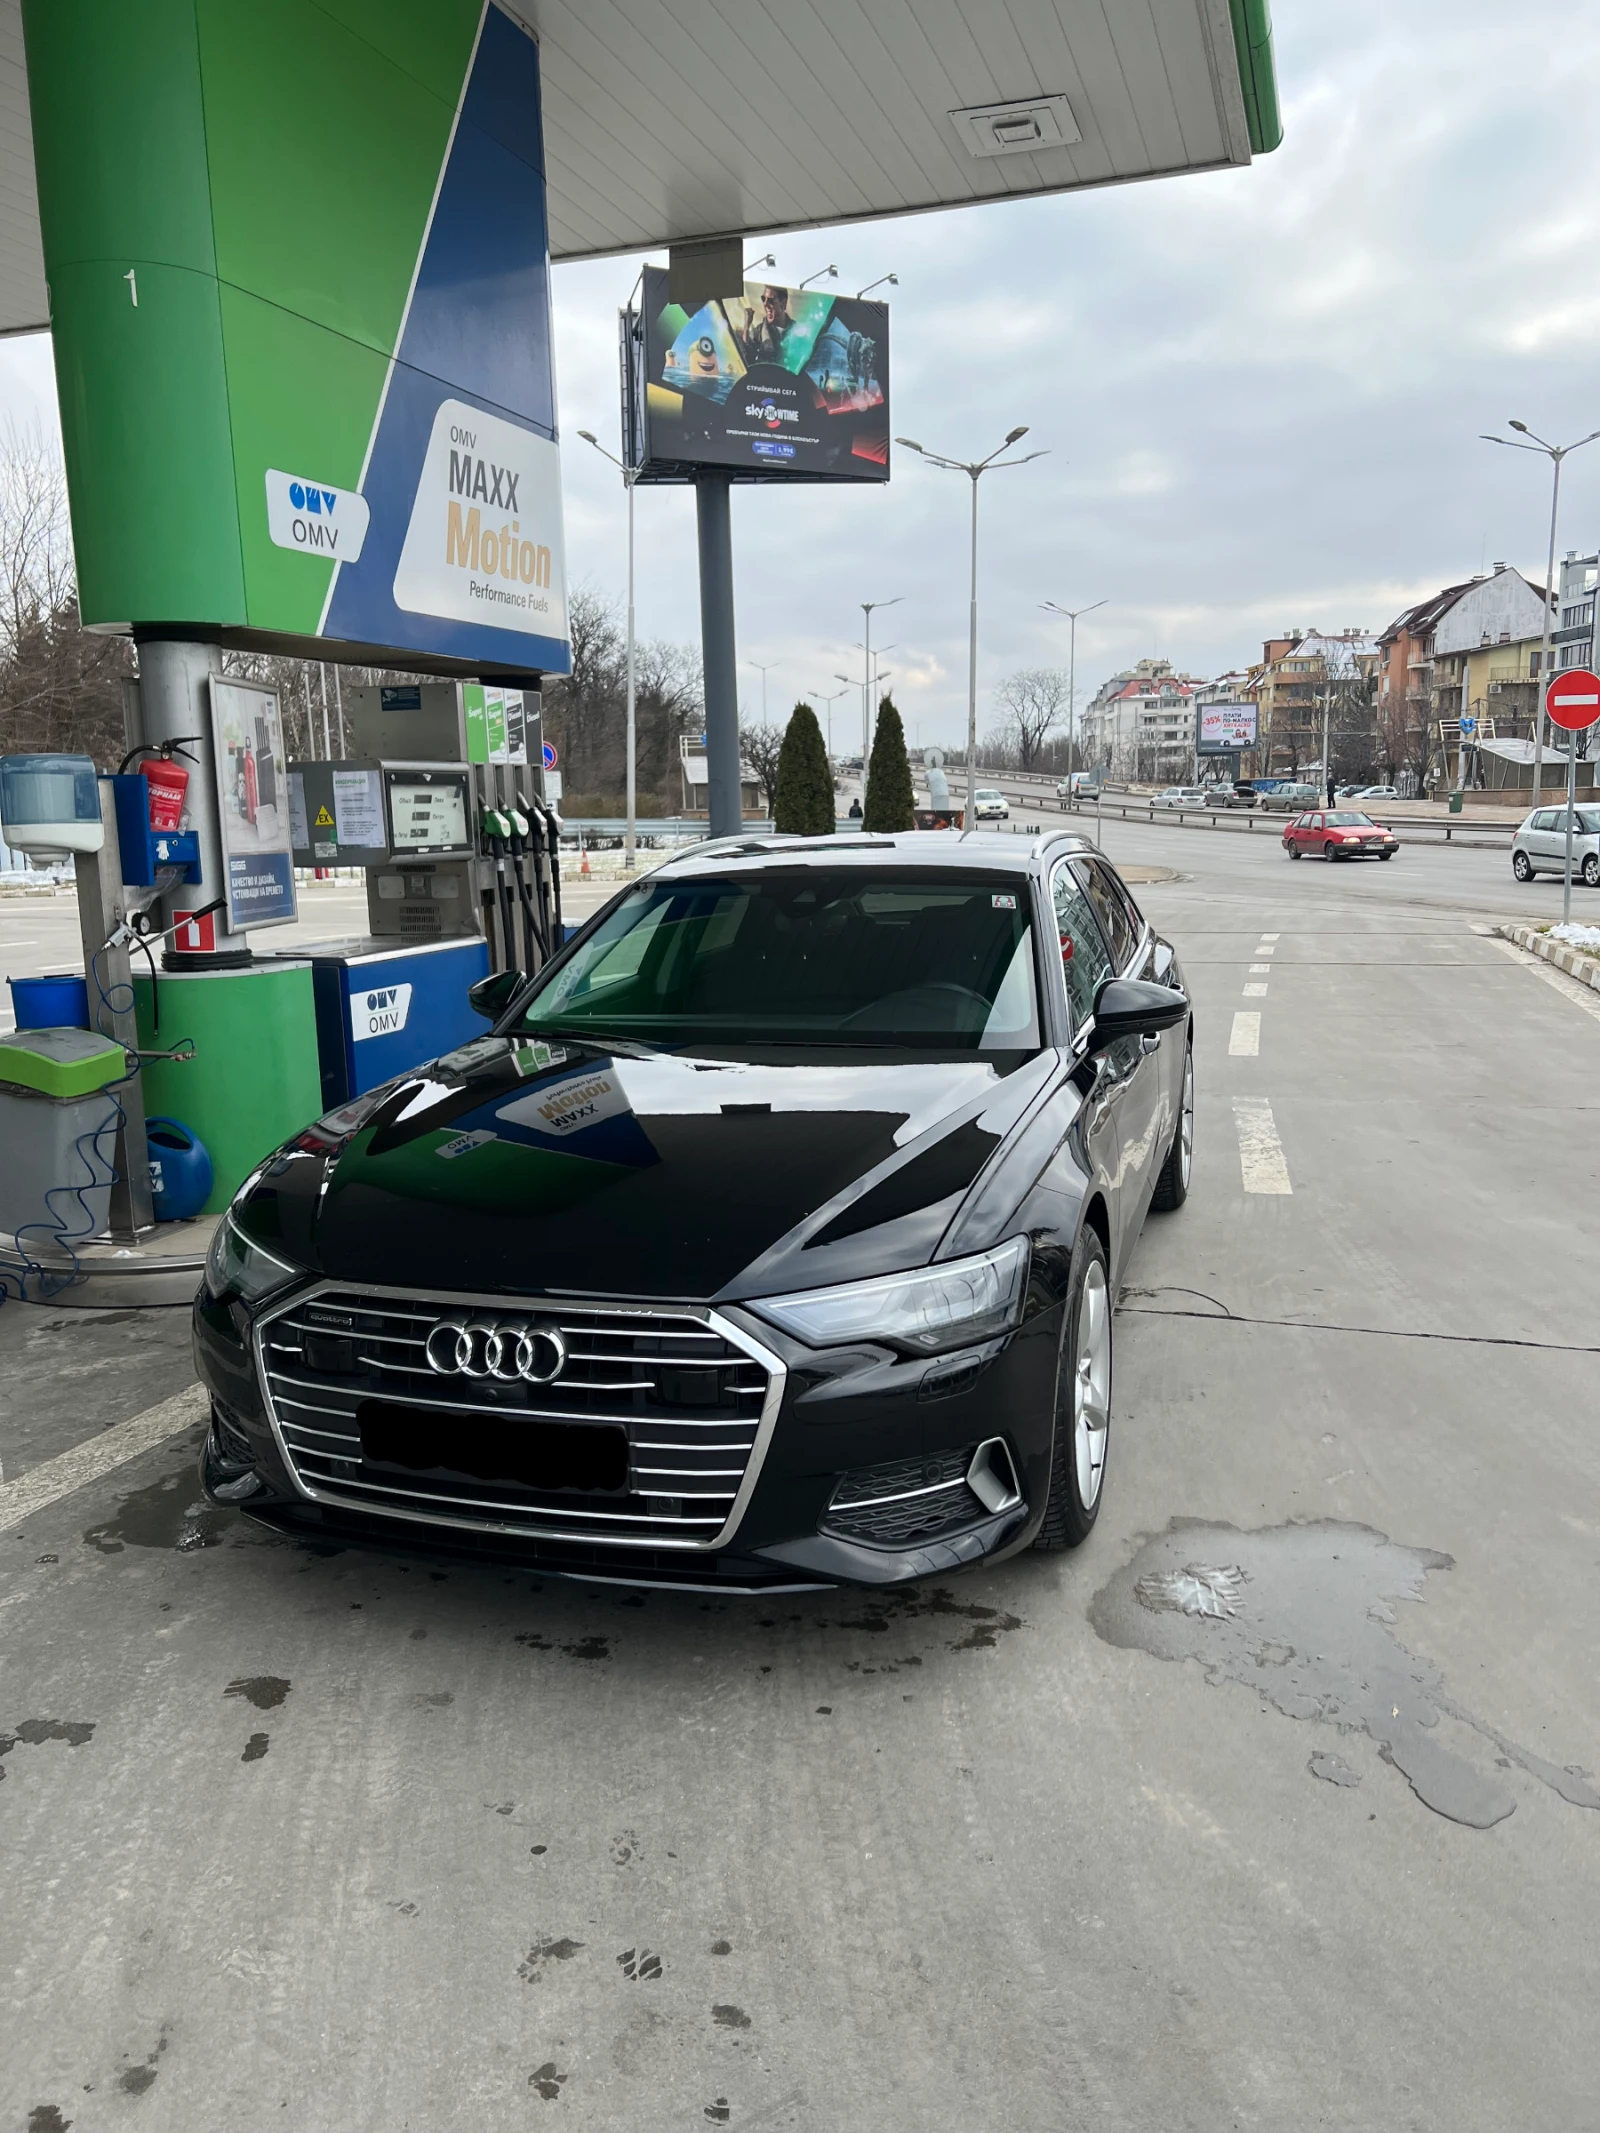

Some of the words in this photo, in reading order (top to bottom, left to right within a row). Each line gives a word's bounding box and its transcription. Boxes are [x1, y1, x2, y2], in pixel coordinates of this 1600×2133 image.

[123, 268, 138, 307] 1
[782, 388, 797, 396] СЕГА
[450, 425, 477, 449] OMV
[449, 449, 520, 513] MAXX
[292, 518, 338, 550] OMV
[446, 500, 551, 589] Motion
[469, 580, 526, 608] Performance
[528, 593, 549, 613] Fuels
[319, 814, 330, 823] EX
[369, 1012, 399, 1034] OMV
[310, 1314, 349, 1324] quattro
